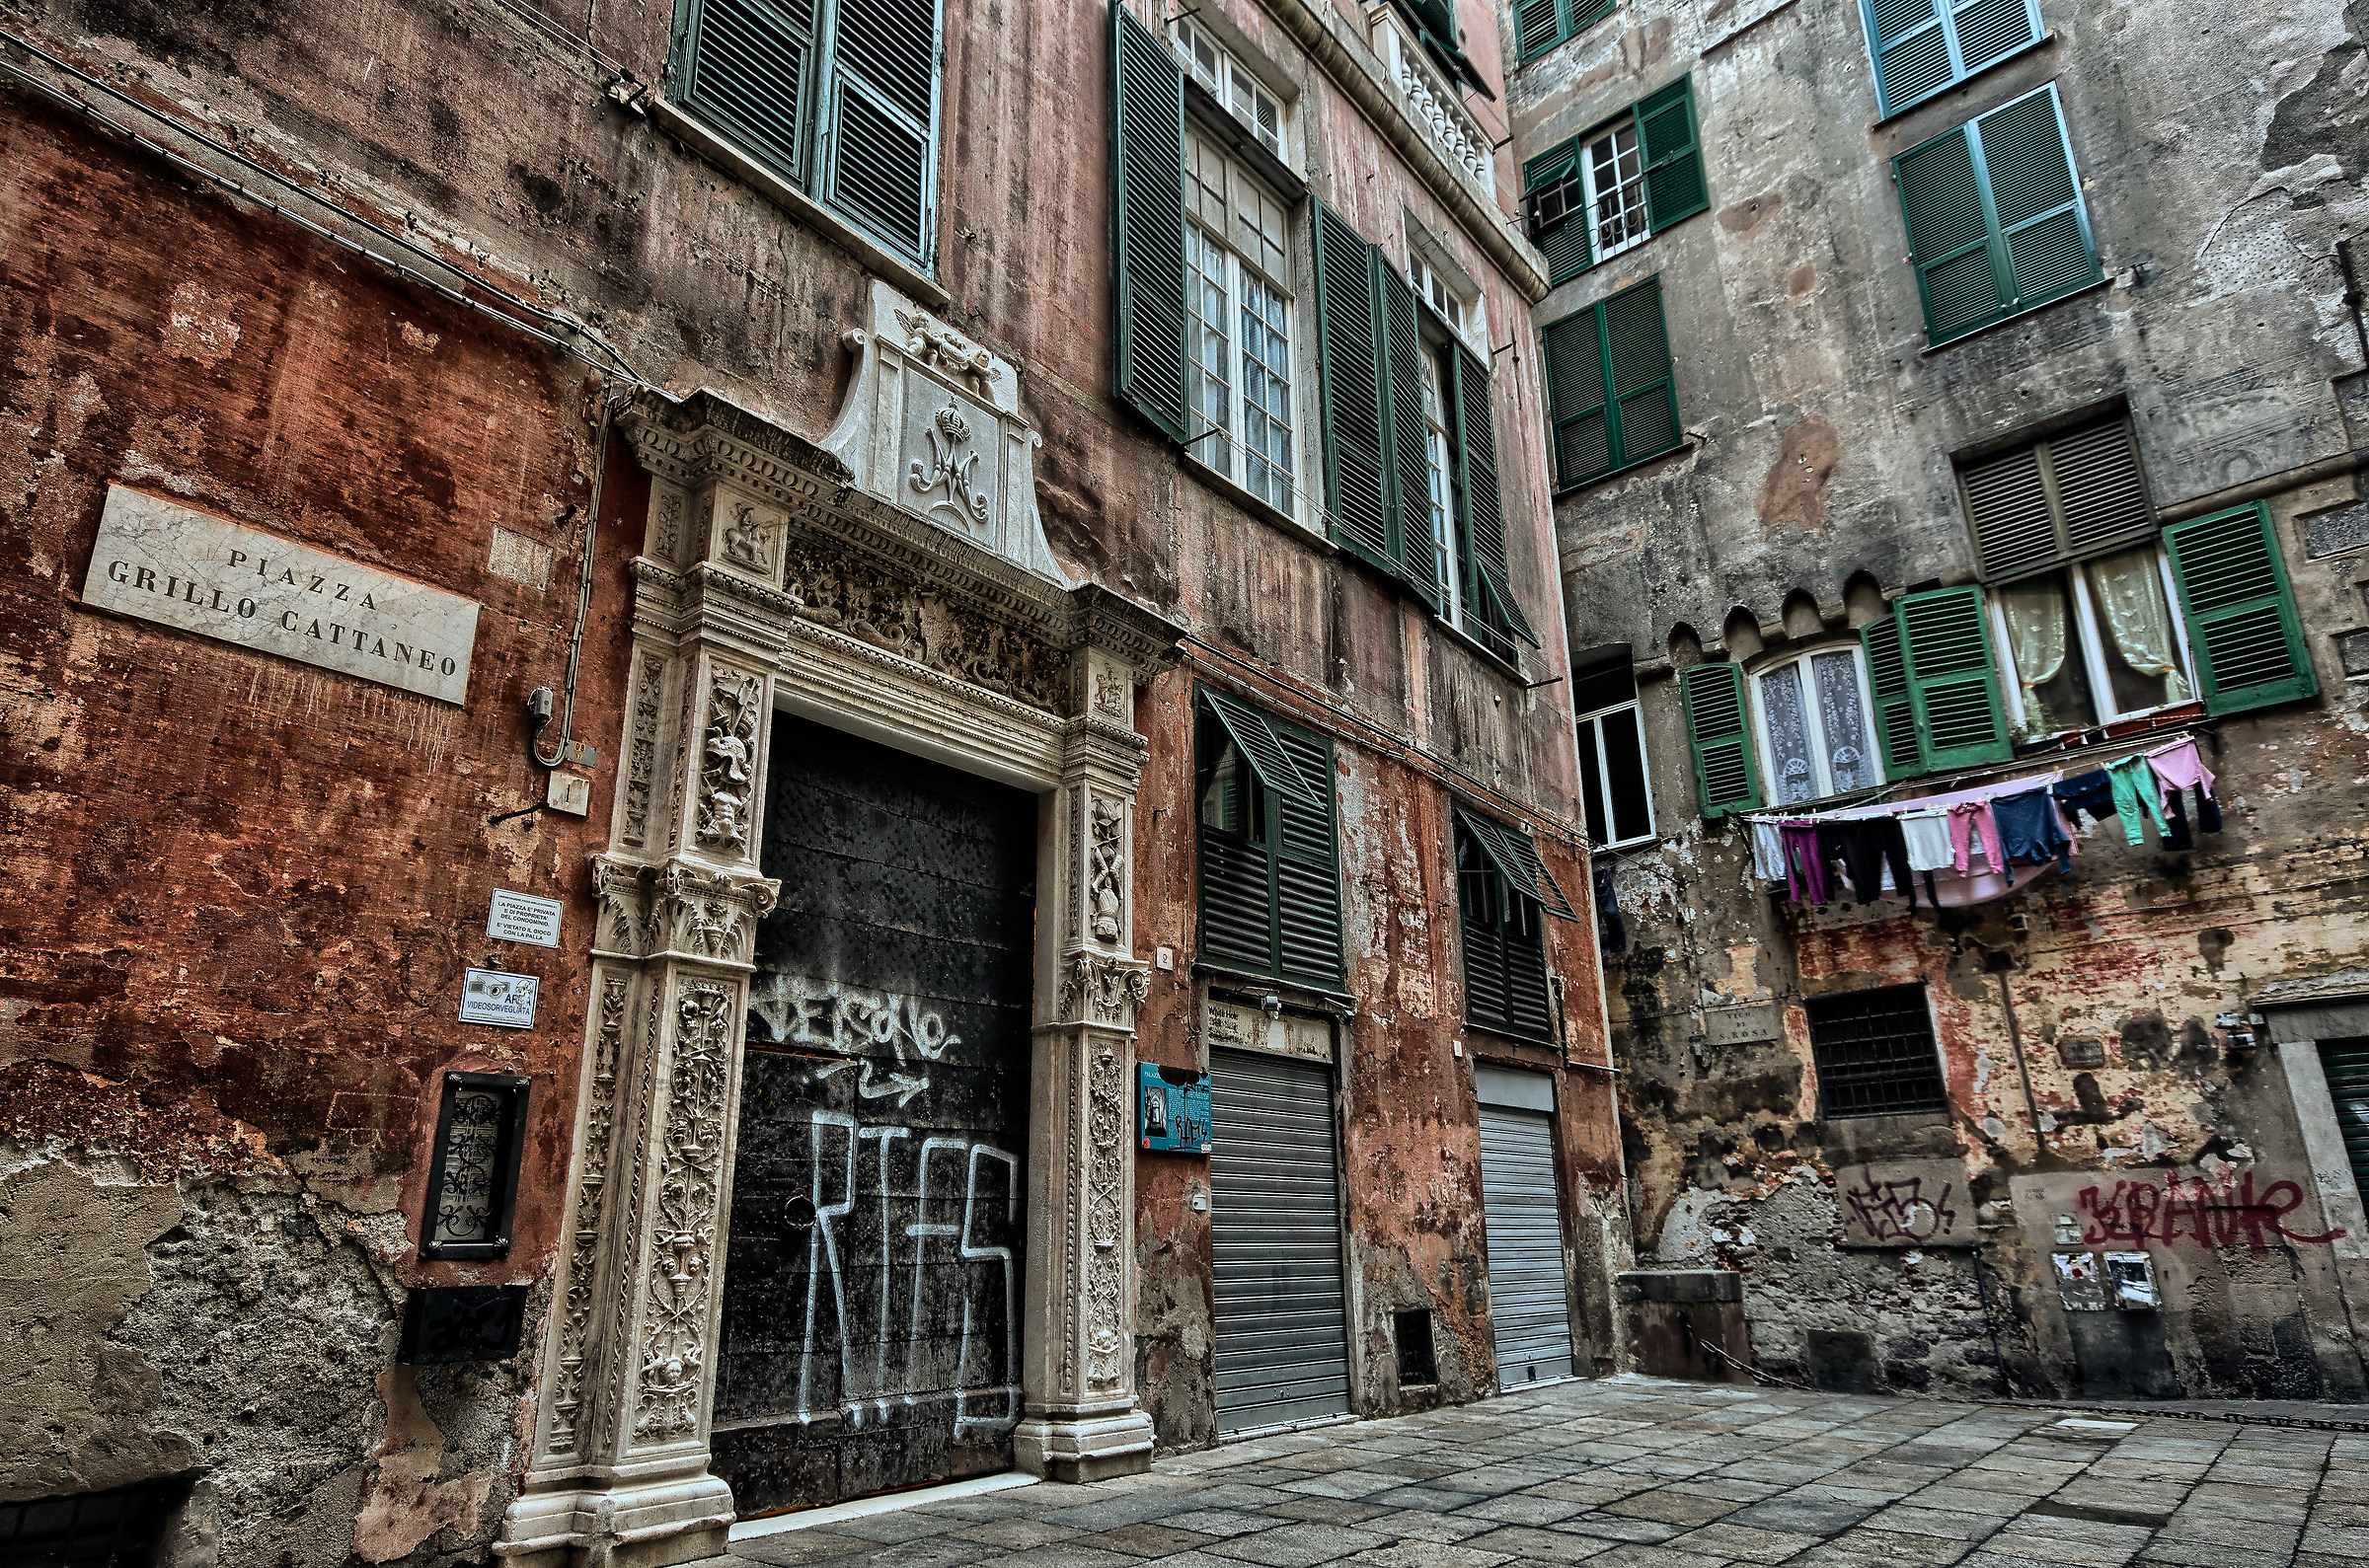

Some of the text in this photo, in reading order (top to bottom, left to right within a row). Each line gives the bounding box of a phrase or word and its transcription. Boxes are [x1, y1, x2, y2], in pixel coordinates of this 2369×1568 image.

[229, 549, 377, 610] PIAZZA
[108, 560, 457, 677] GRILLO CATTANEO
[506, 902, 526, 911] PIAZZA
[513, 916, 549, 927] CONDOMINIO.
[1163, 953, 1168, 963] 2
[504, 993, 531, 1007] ARA
[468, 1001, 530, 1014] VIDEOSORVEGLIATA
